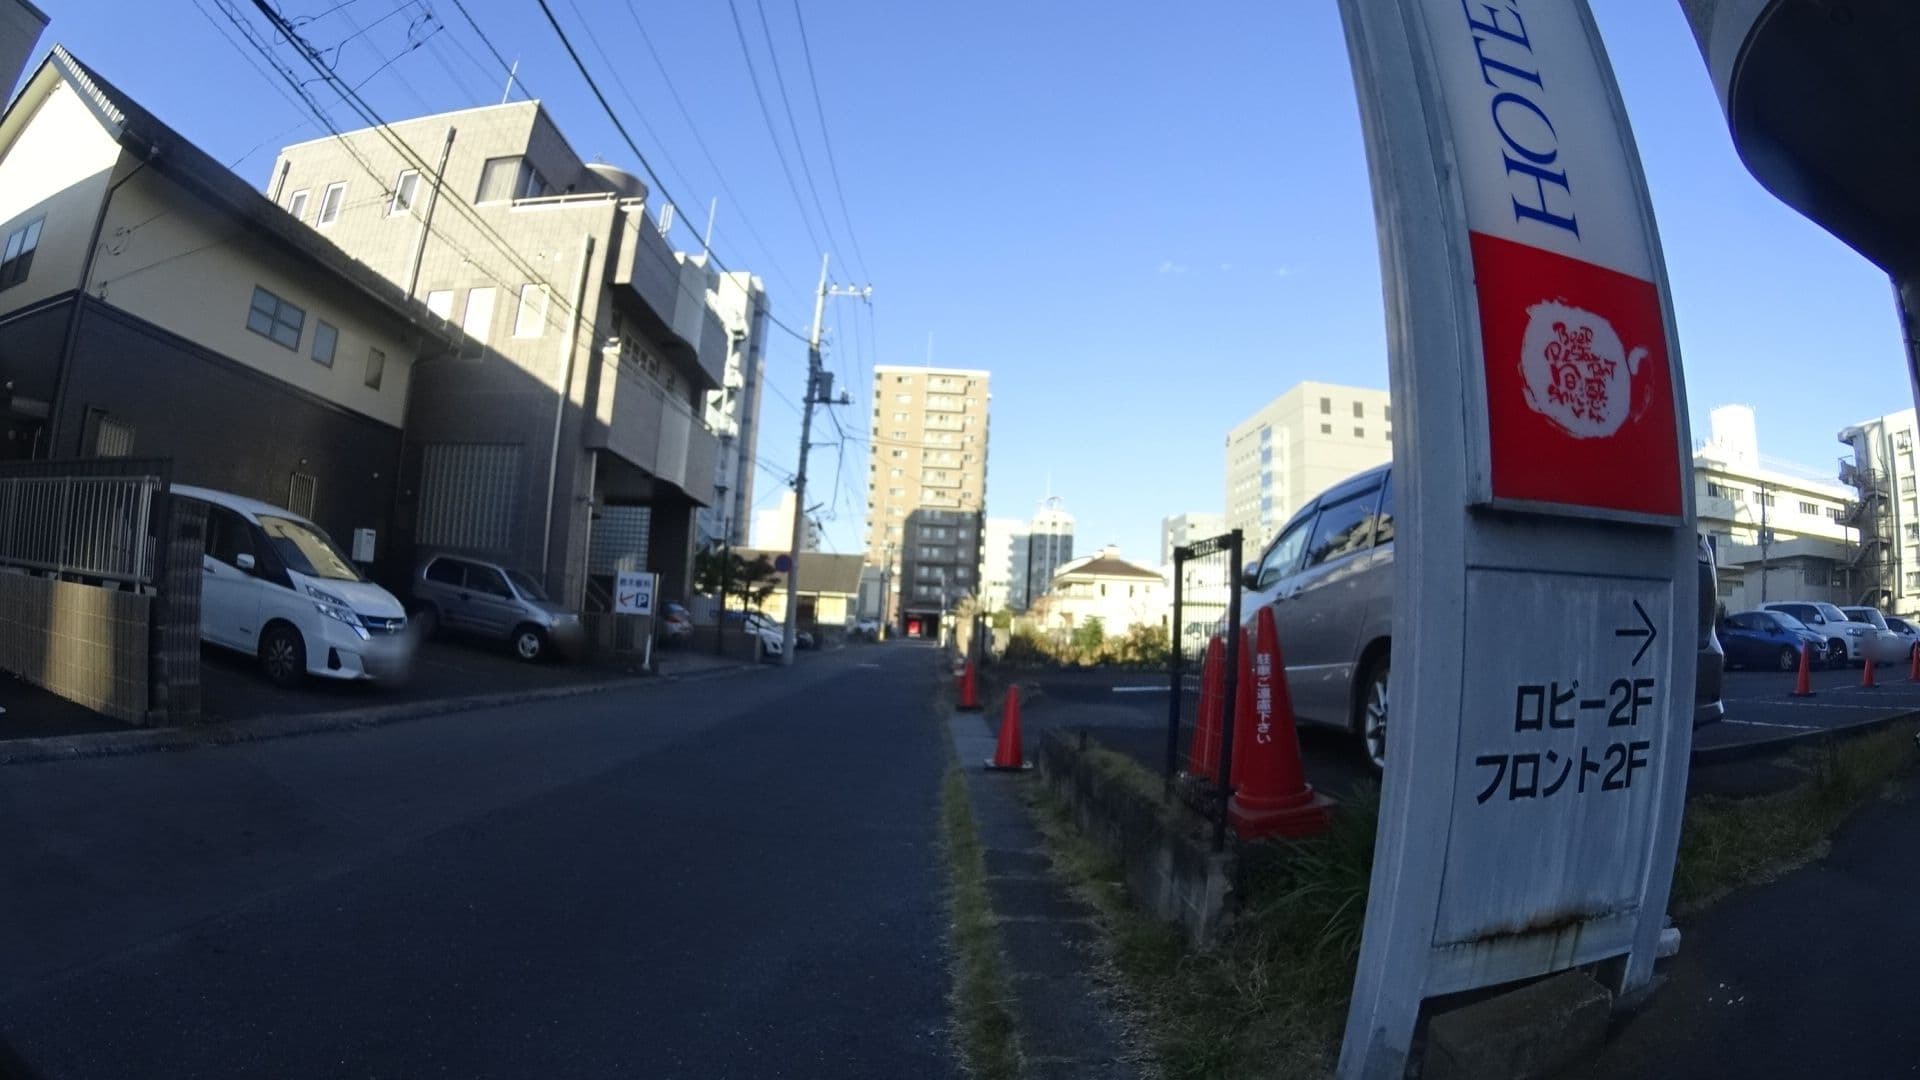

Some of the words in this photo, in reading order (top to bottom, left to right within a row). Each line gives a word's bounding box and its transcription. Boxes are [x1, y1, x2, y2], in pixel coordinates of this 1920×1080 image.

[1462, 0, 1581, 242] HOTE
[1514, 678, 1655, 733] ロビー2F
[1475, 740, 1650, 805] フロント2F
